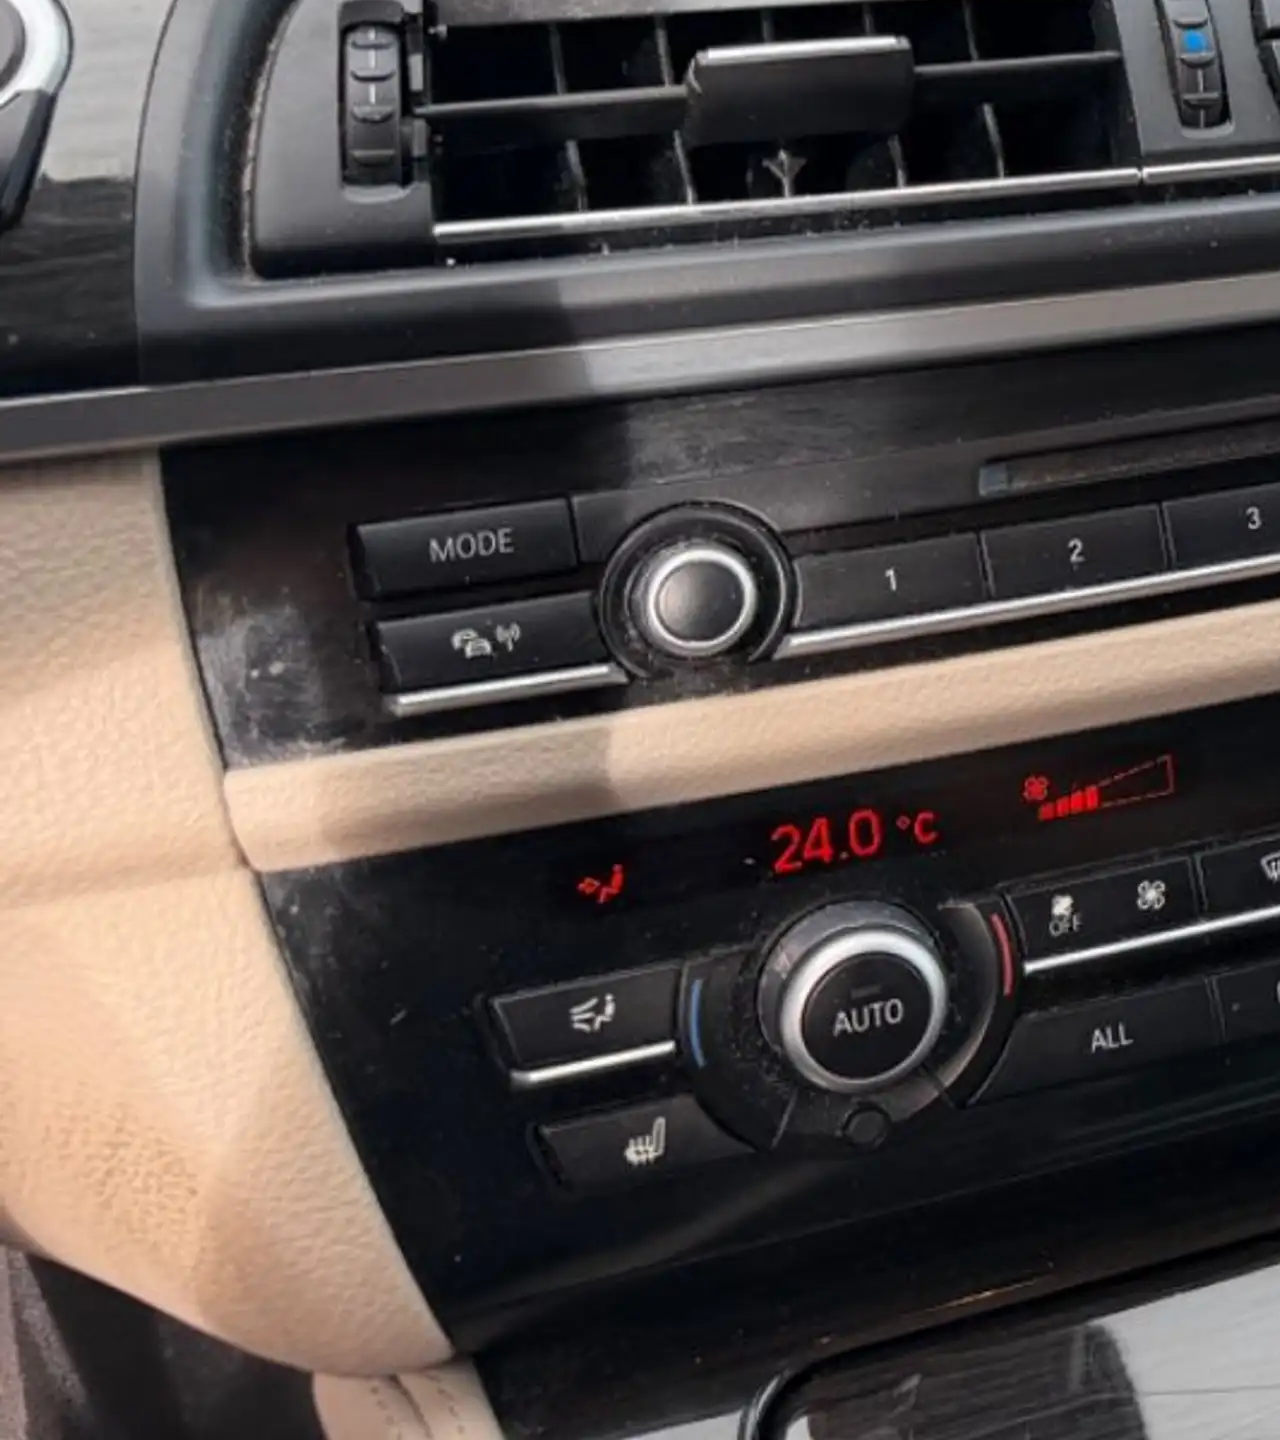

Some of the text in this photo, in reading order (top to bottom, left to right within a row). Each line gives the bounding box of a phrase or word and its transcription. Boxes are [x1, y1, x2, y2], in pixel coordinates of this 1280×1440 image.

[1245, 506, 1262, 531] 3
[429, 527, 514, 564] MODE
[1067, 537, 1085, 564] 2
[884, 568, 898, 593] 1
[771, 809, 882, 874] 24.0
[832, 997, 905, 1038] AUTO
[1090, 1022, 1135, 1054] ALL
